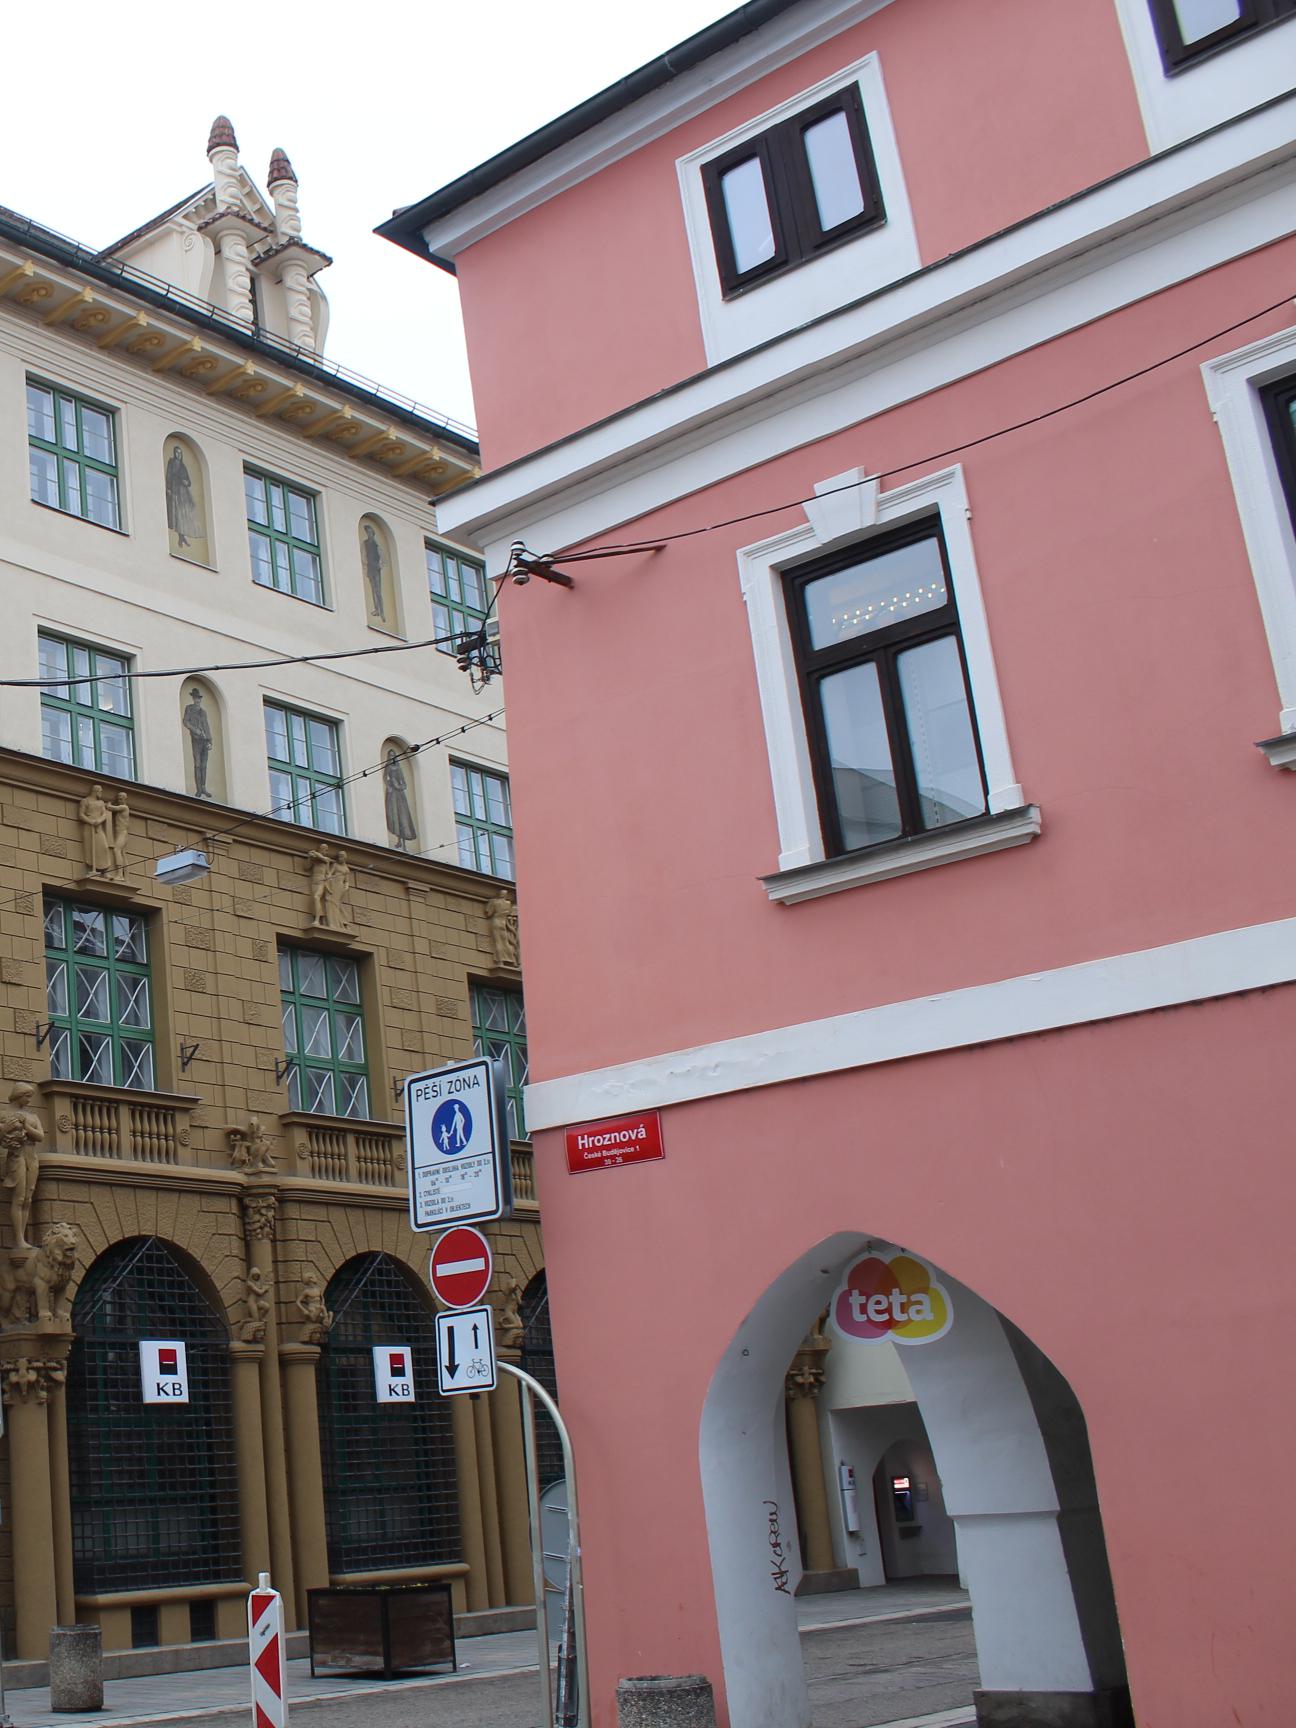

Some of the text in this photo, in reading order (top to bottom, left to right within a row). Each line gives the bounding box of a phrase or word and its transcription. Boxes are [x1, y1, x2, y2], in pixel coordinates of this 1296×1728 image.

[416, 1074, 480, 1102] PĚŠÍ ZÓNA
[577, 1123, 647, 1150] Hroznová
[583, 1150, 602, 1160] České
[602, 1145, 634, 1157] Budějovice
[849, 1288, 934, 1322] teta
[156, 1382, 183, 1397] KB
[388, 1383, 410, 1397] KB
